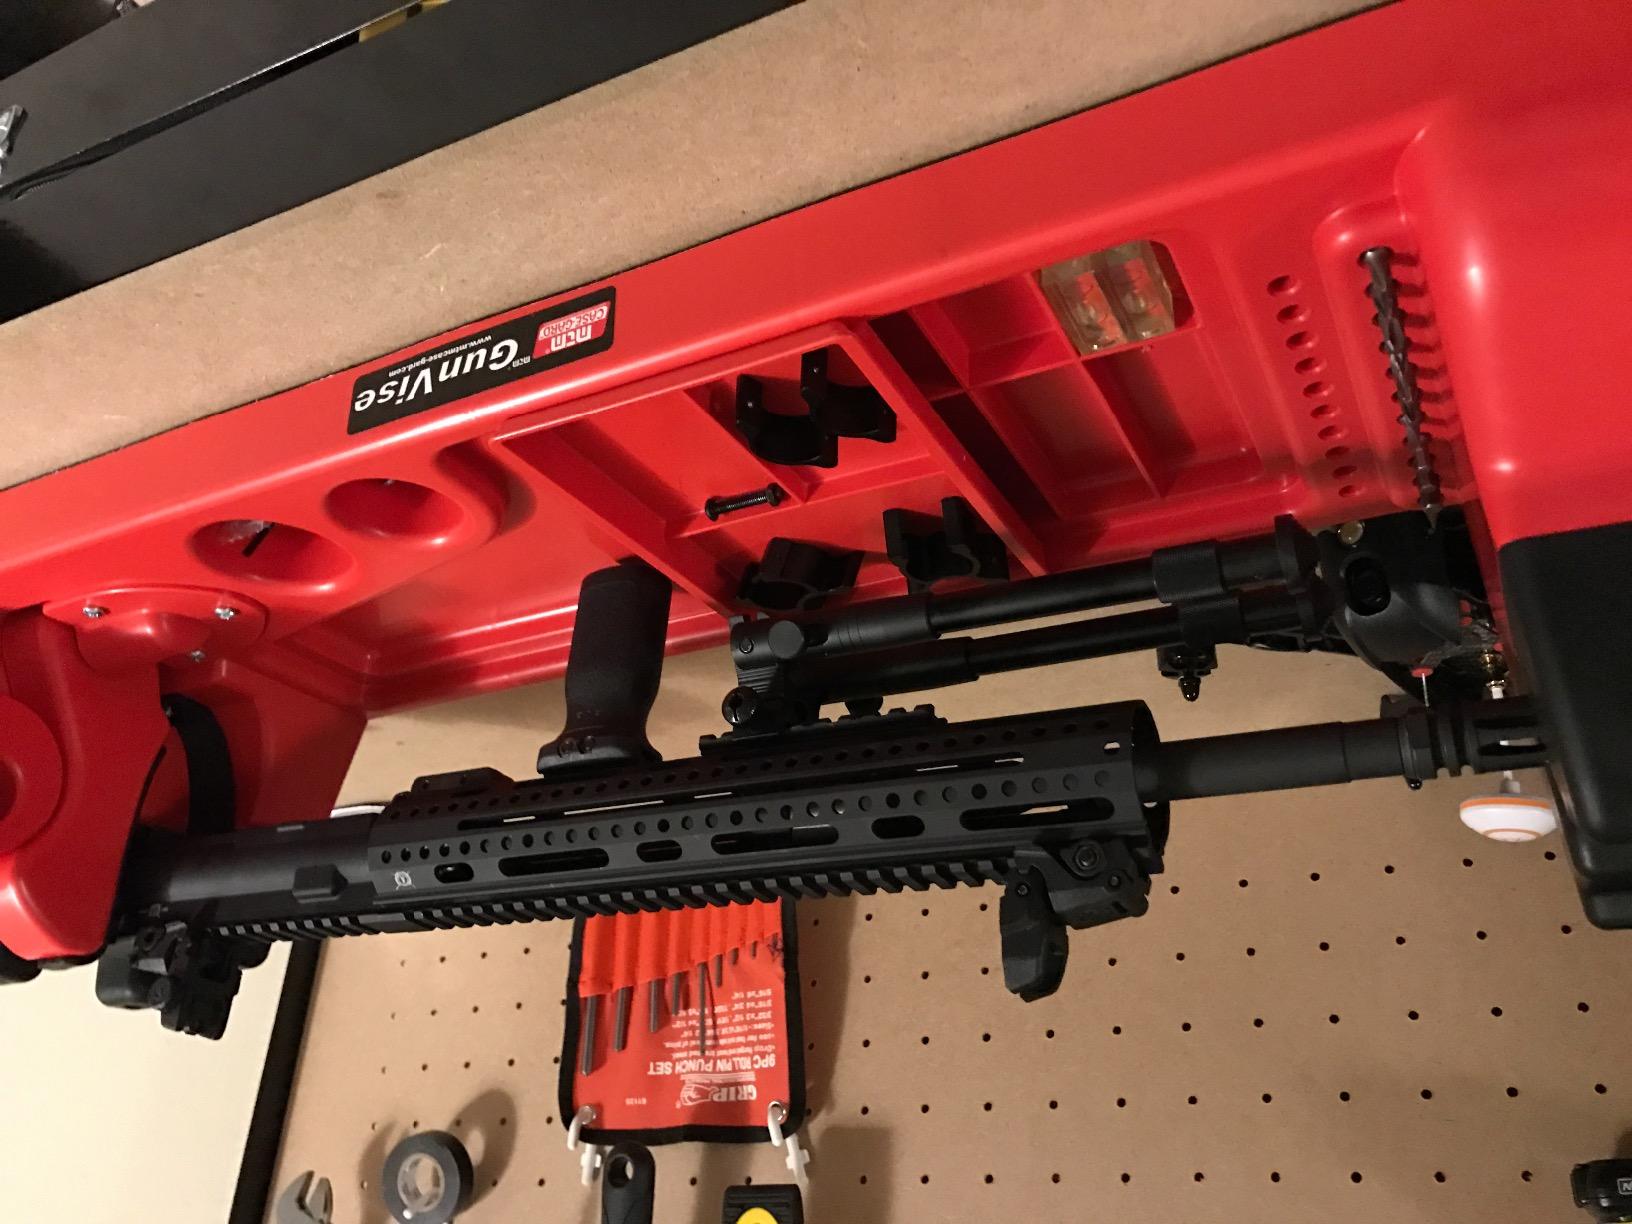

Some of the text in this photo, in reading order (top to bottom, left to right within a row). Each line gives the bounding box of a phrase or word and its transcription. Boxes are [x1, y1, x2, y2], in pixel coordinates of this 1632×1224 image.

[388, 334, 492, 377] www.mtmcase-gard.com
[354, 338, 519, 412] Gun Vise
[647, 1061, 673, 1076] SET
[675, 1059, 713, 1075] PUNCH
[716, 1058, 732, 1072] PIN
[732, 1057, 752, 1070] ROLL
[753, 1053, 776, 1069] 9PC
[712, 1085, 757, 1102] GRIP
